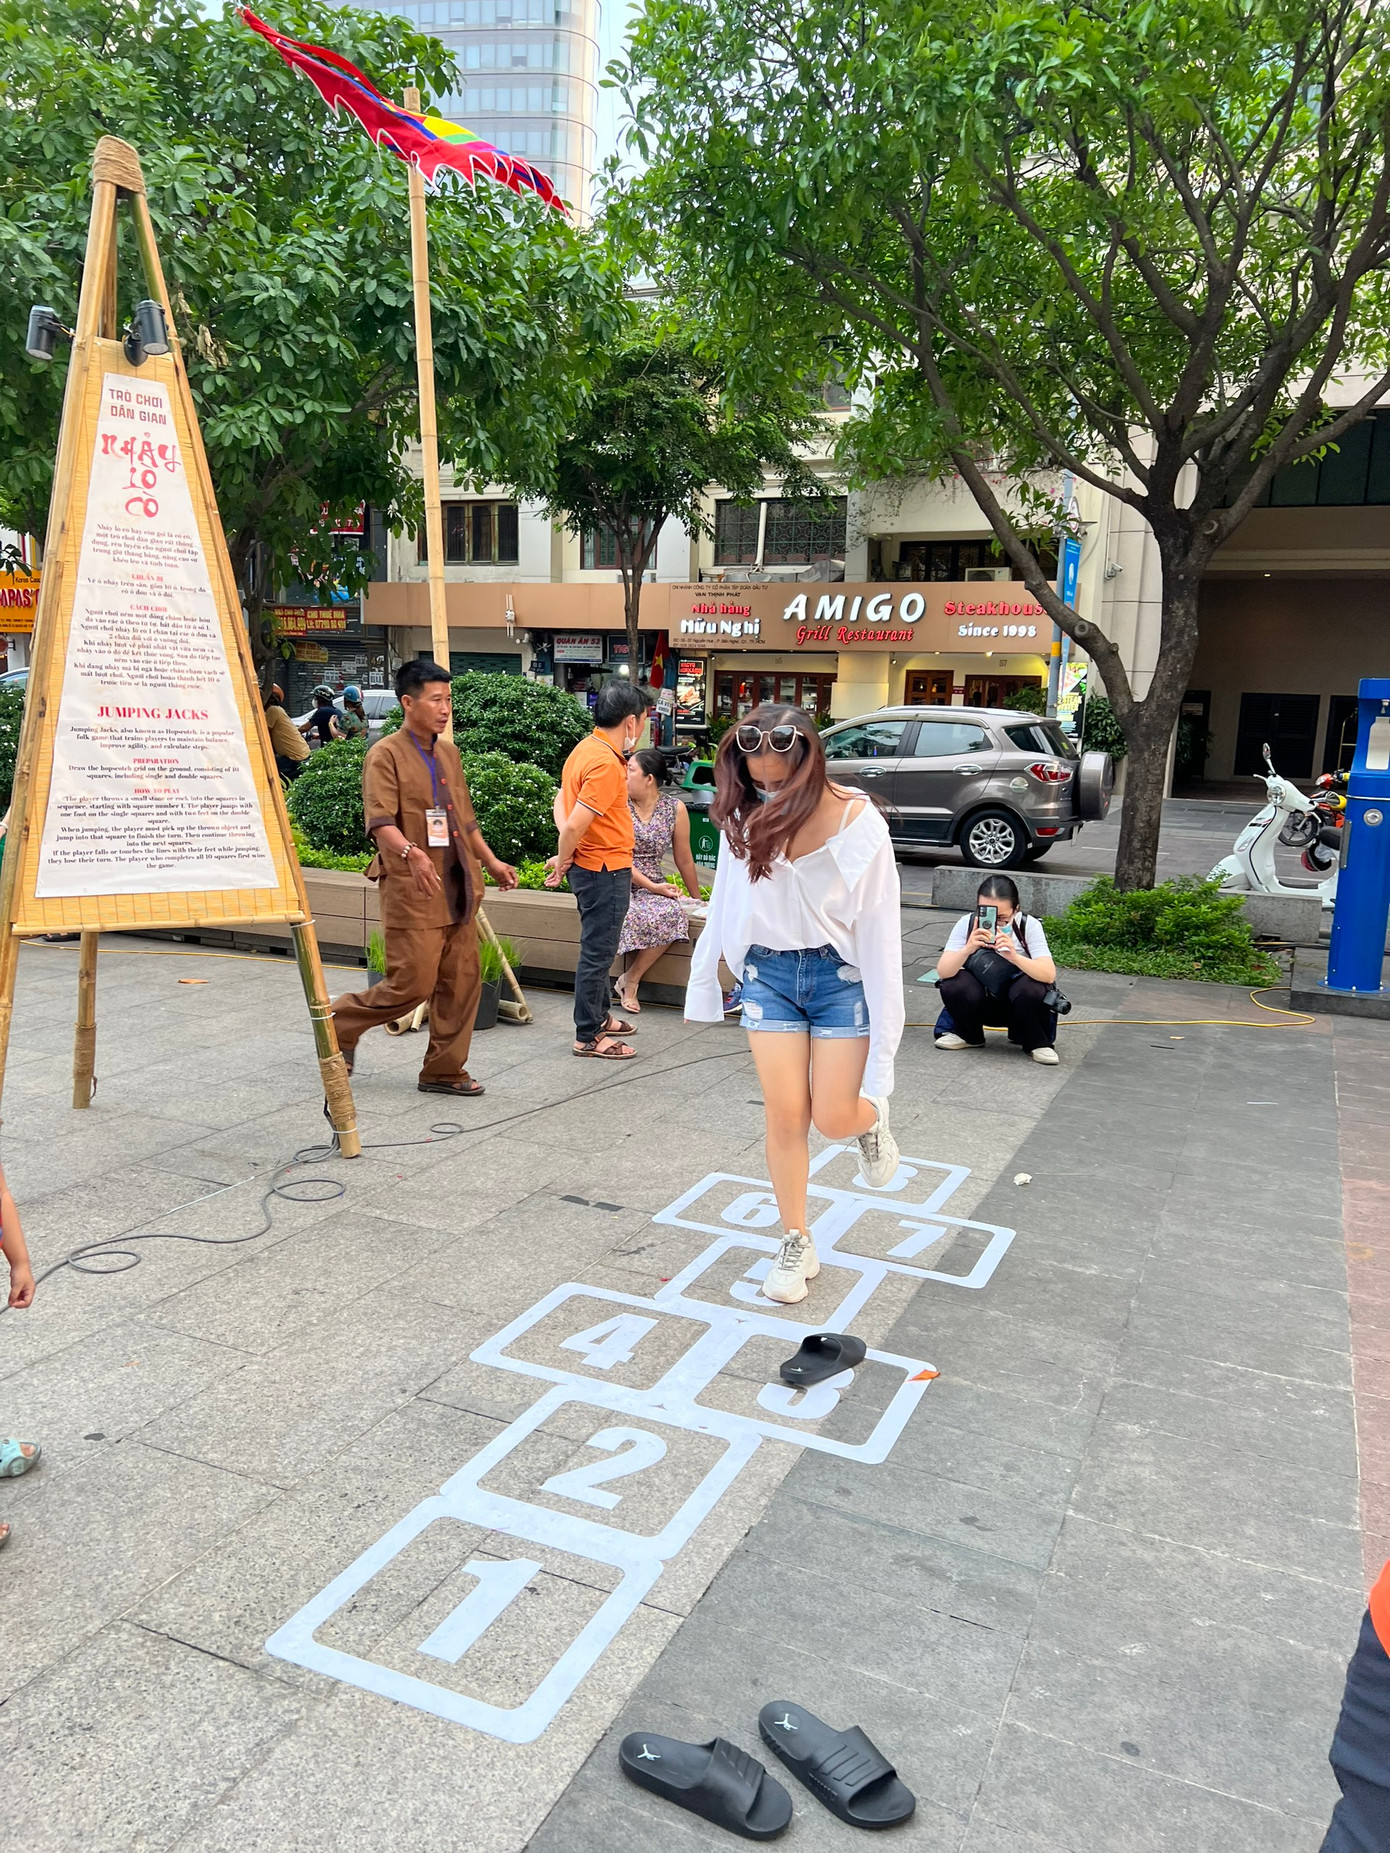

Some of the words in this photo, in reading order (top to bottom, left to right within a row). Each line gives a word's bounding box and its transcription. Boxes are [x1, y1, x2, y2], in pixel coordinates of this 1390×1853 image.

[109, 388, 132, 402] TRÒ
[136, 394, 162, 408] CHƠI
[110, 405, 134, 420] DÂN
[140, 410, 166, 425] GIAN
[102, 432, 182, 472] NHẢY
[783, 592, 926, 622] AMIGO
[944, 600, 1048, 616] Steakhous
[680, 618, 718, 634] Hữu
[720, 618, 762, 640] Nghị
[796, 626, 832, 646] Grill
[837, 626, 914, 644] Restaurant
[958, 622, 999, 637] Since
[1002, 625, 1037, 638] 1998
[97, 706, 160, 718] JUMPING
[165, 708, 208, 720] JACKS
[70, 726, 98, 734] Jumping
[211, 729, 234, 737] popular
[99, 742, 125, 750] improve
[144, 735, 167, 743] players
[100, 765, 131, 773] hopscotch
[133, 765, 146, 773] grid
[193, 765, 223, 773] consisting
[114, 773, 143, 781] including
[145, 773, 162, 781] single
[79, 795, 99, 803] player
[89, 803, 114, 811] starting
[199, 802, 218, 810] player
[219, 802, 237, 810] jumps
[110, 810, 128, 818] single
[123, 825, 143, 833] player
[161, 825, 174, 833] pick
[55, 834, 73, 842] jump
[47, 857, 61, 865] they
[128, 855, 148, 863] player
[164, 854, 194, 862] completes
[72, 848, 93, 857] player
[886, 1220, 948, 1258] 7
[558, 1312, 660, 1369] 4
[538, 1426, 668, 1510] 2
[416, 1558, 544, 1664] 1
